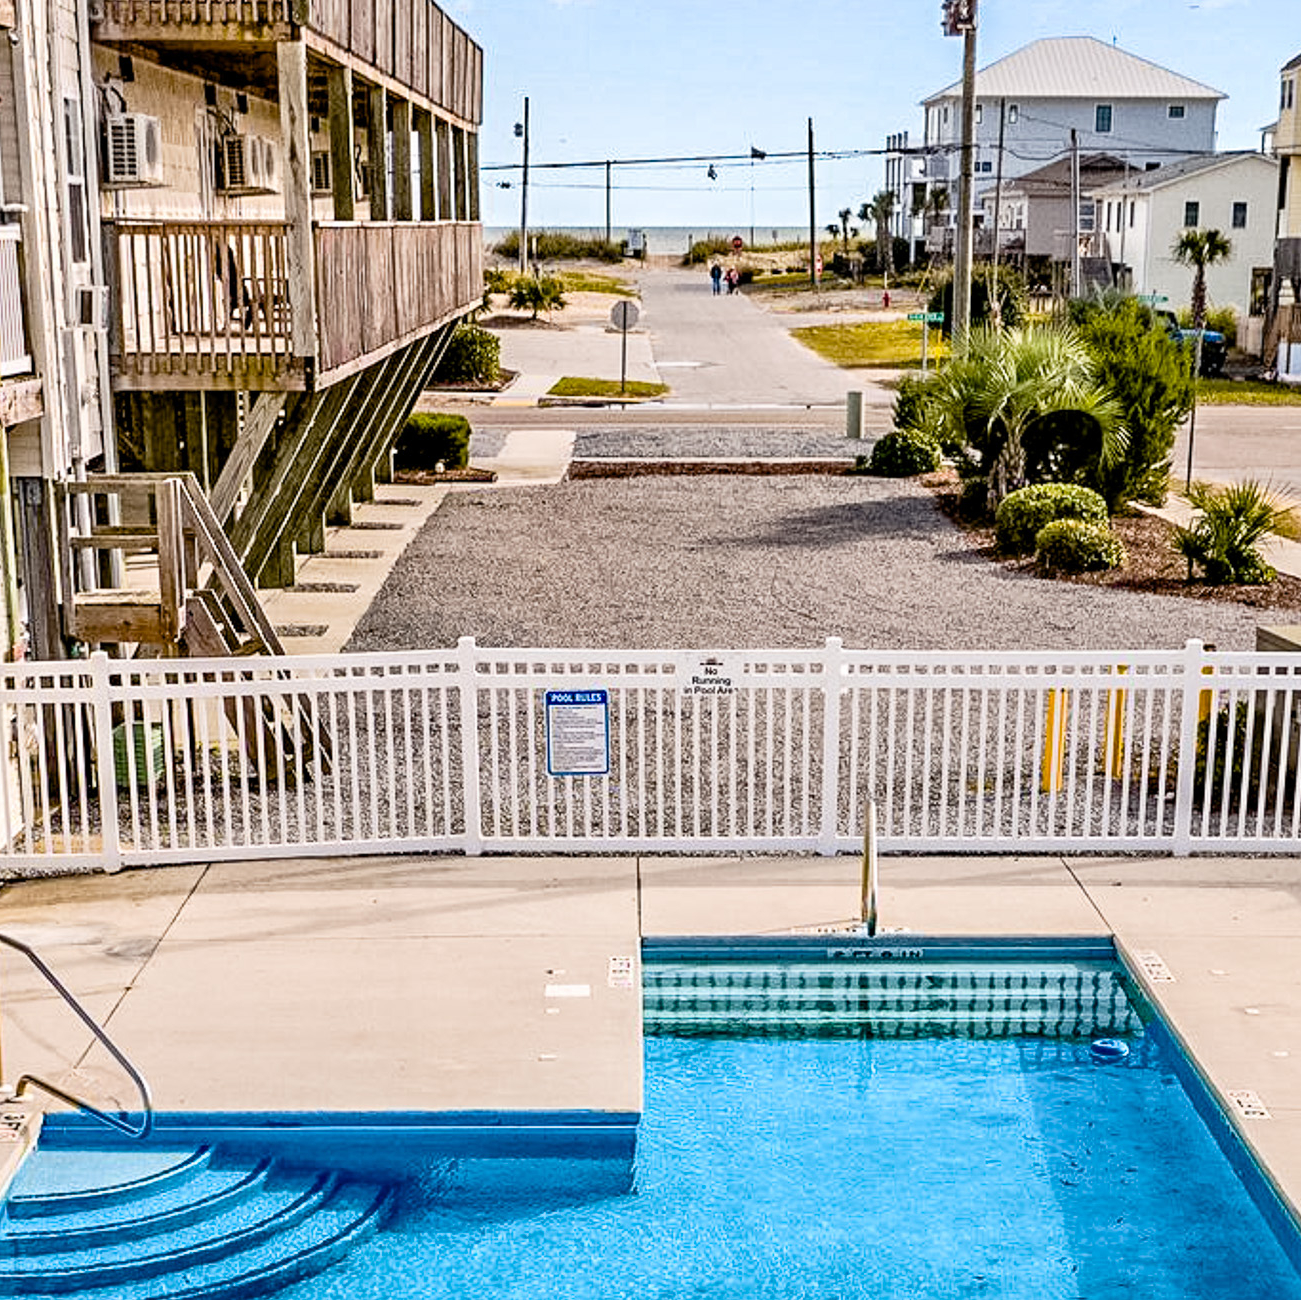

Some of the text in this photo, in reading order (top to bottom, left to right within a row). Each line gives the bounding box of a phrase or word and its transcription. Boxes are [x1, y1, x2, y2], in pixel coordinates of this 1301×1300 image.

[705, 667, 718, 675] No
[692, 676, 731, 686] Running
[694, 686, 716, 694] Pool
[551, 692, 602, 702] POOL RULES
